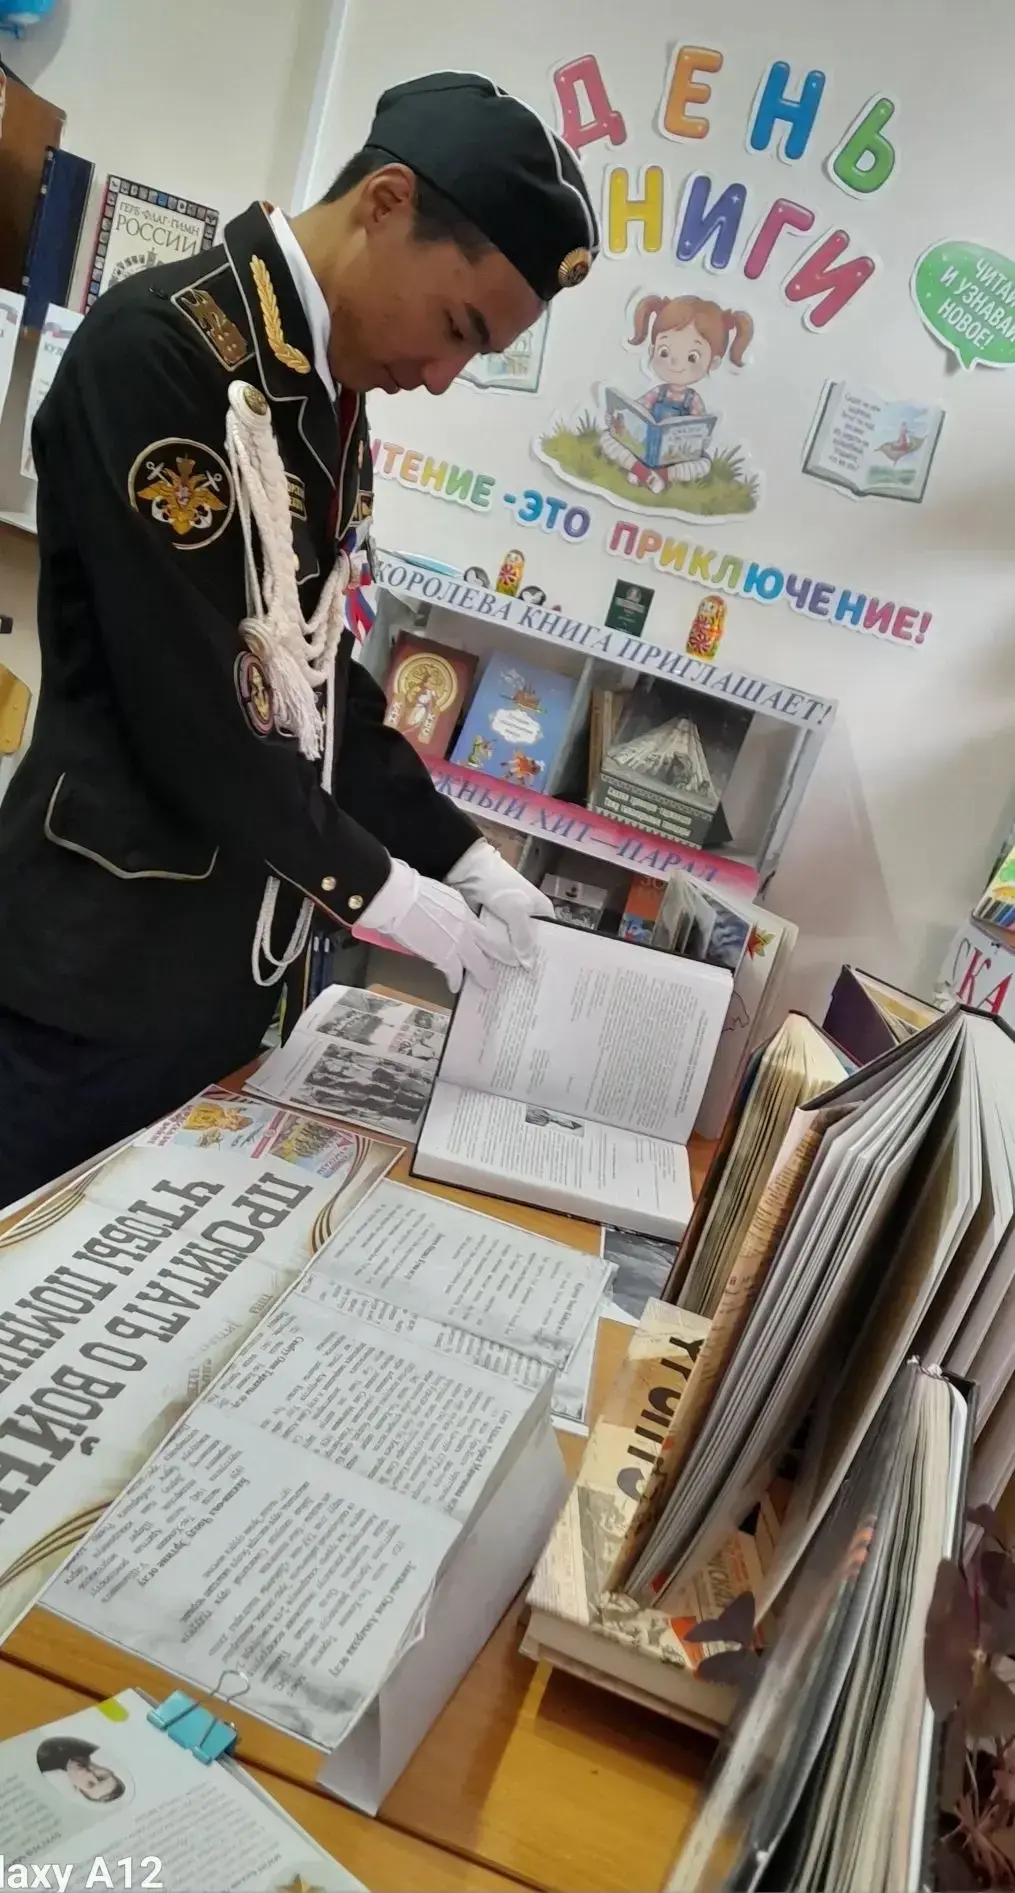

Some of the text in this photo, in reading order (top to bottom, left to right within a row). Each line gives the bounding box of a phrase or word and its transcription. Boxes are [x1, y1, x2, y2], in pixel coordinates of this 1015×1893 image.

[553, 45, 896, 194] ДЕНЬ
[115, 214, 198, 257] РОССИИ
[940, 265, 959, 287] И
[937, 297, 995, 350] НОВОЕ!
[608, 520, 933, 645] ПРИКЛЮЧЕНИЕ!
[375, 559, 514, 622] КОРОЛЕВА
[517, 603, 614, 654] КНИГА
[616, 630, 834, 726] ПРИГЛАШАЕТ!
[71, 1179, 226, 1275] ЧТОБЫ
[109, 1172, 314, 1345] ПРОЧИТАТЬ
[79, 1341, 149, 1375] О
[0, 1365, 133, 1516] ВОЙН
